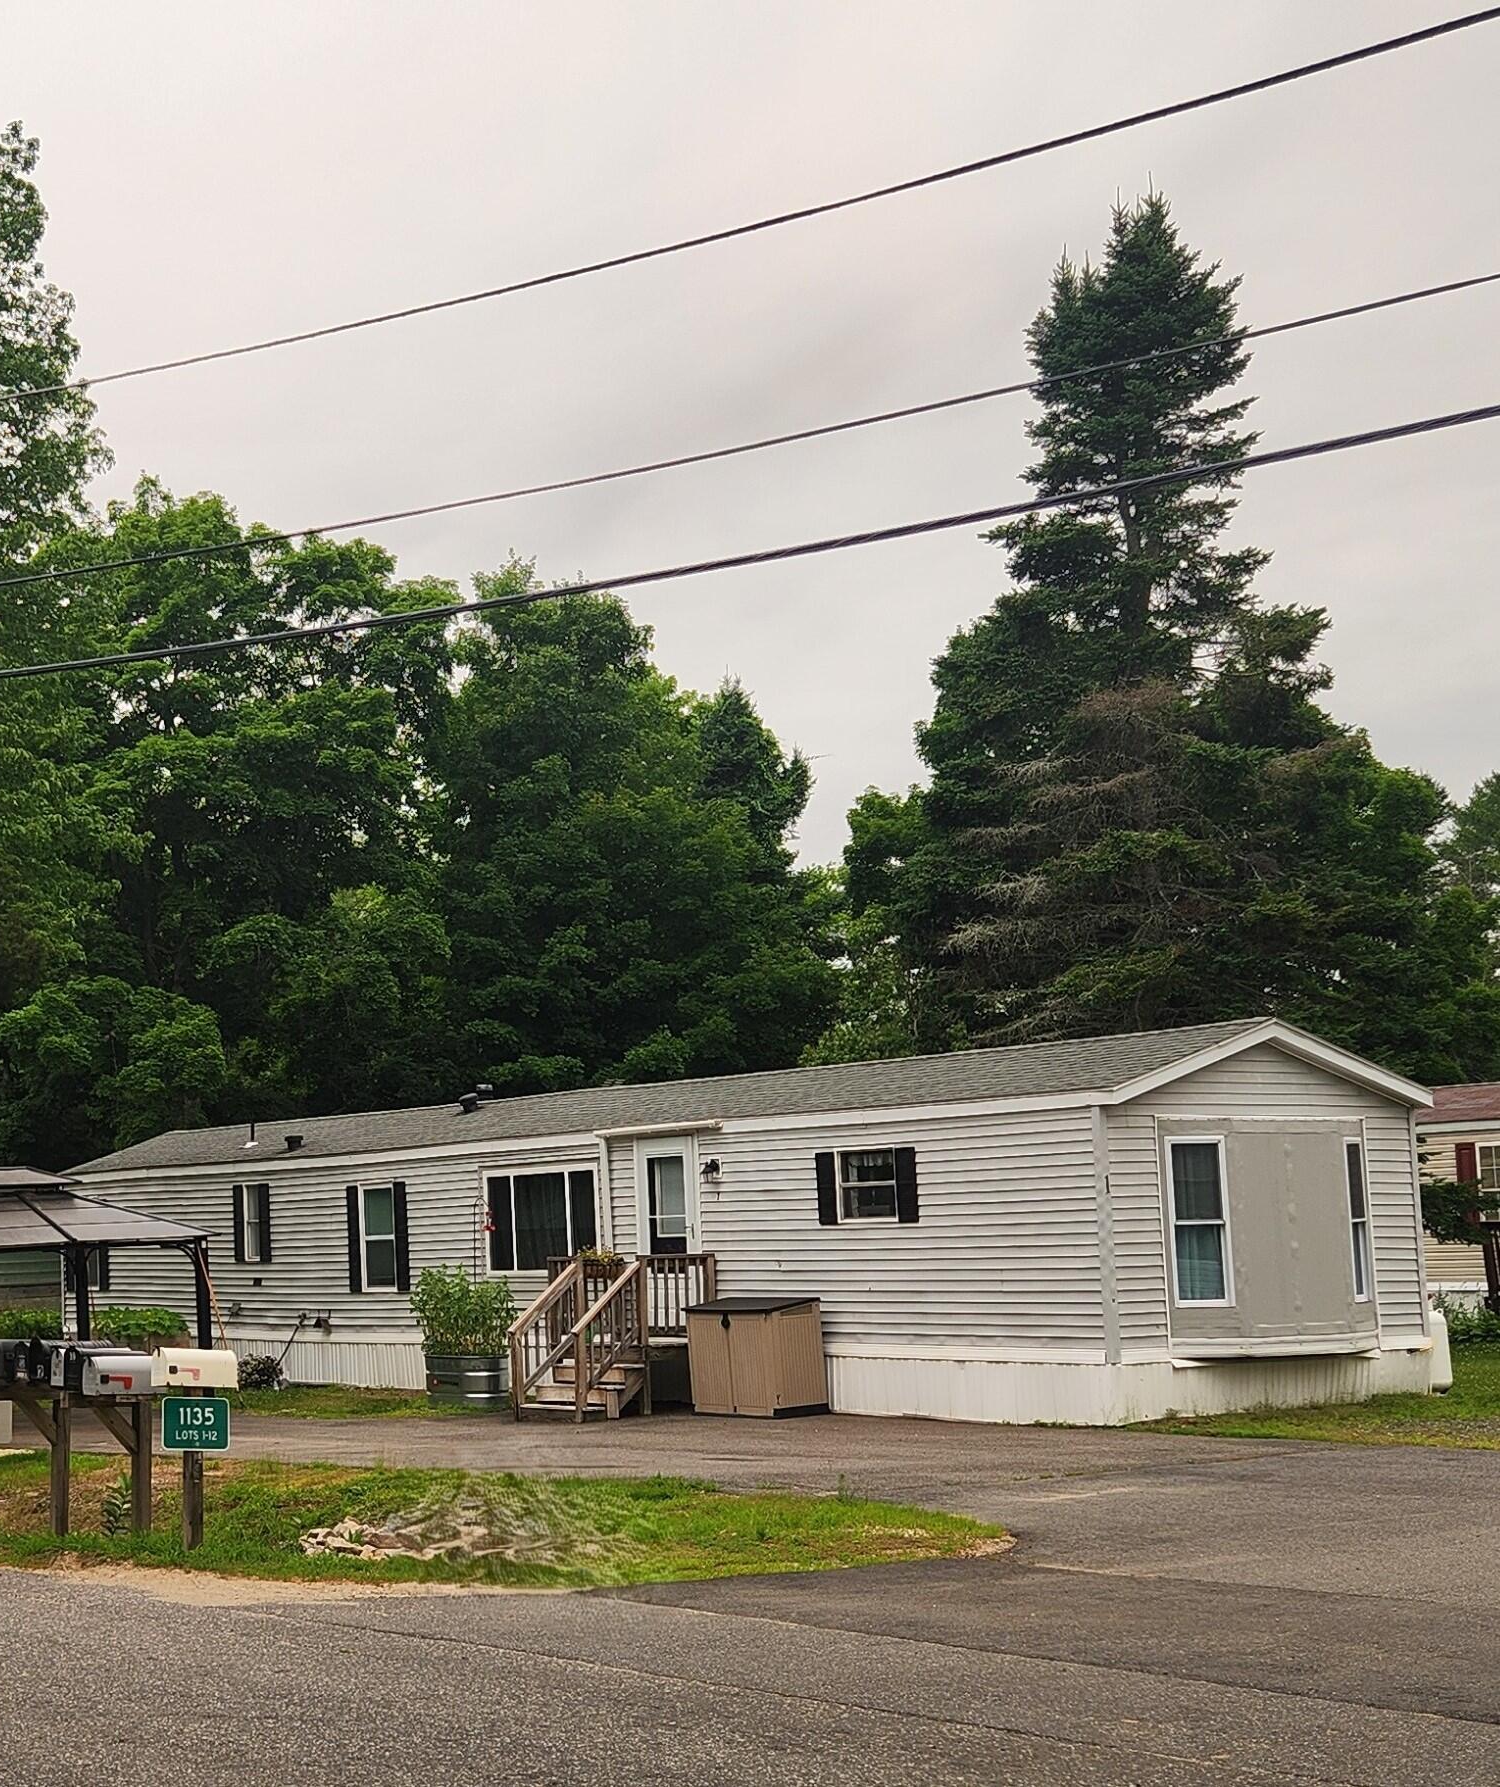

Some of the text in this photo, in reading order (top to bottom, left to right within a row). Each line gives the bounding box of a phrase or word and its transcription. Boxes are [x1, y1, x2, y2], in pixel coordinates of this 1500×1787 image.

[179, 1407, 215, 1426] 1135
[175, 1430, 218, 1441] LOTS 1-12
